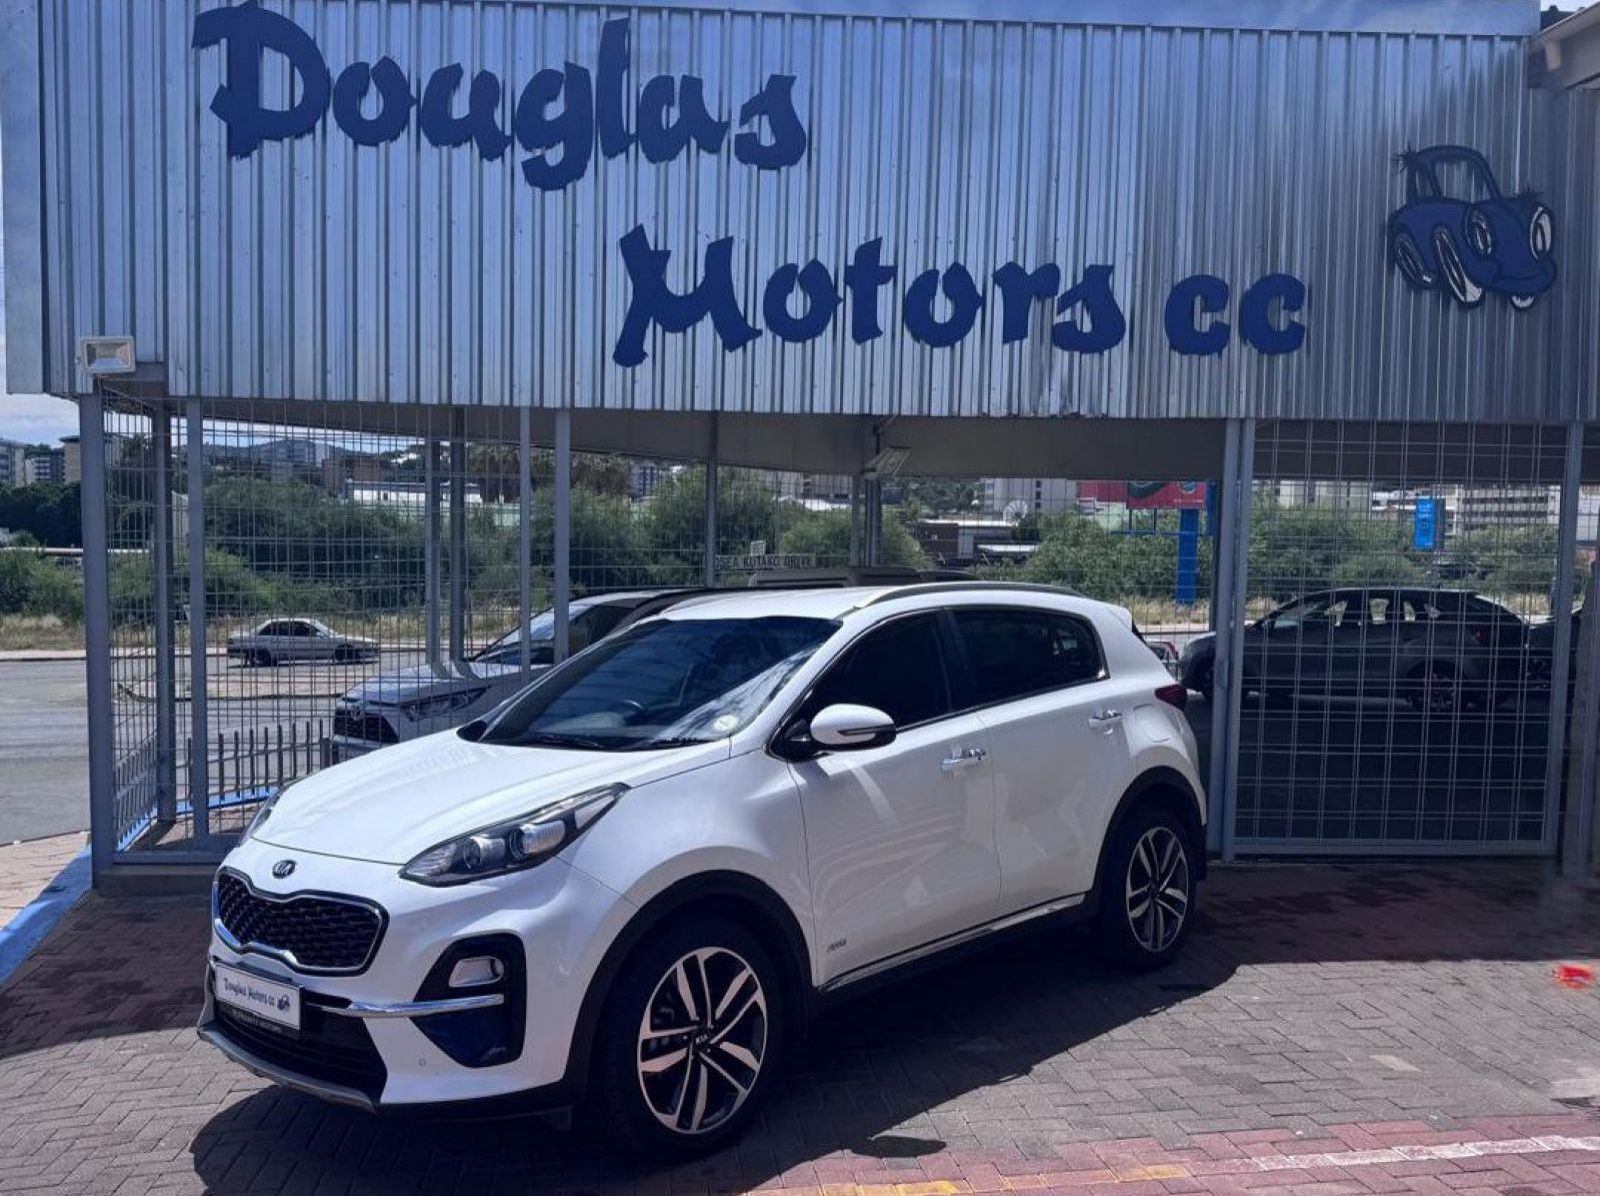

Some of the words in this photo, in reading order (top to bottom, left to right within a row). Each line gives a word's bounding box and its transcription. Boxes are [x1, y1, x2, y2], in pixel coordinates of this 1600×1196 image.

[192, 1, 806, 190] Douglas
[613, 223, 1126, 367] Motors
[1164, 273, 1306, 356] cc
[713, 556, 740, 569] OSEA
